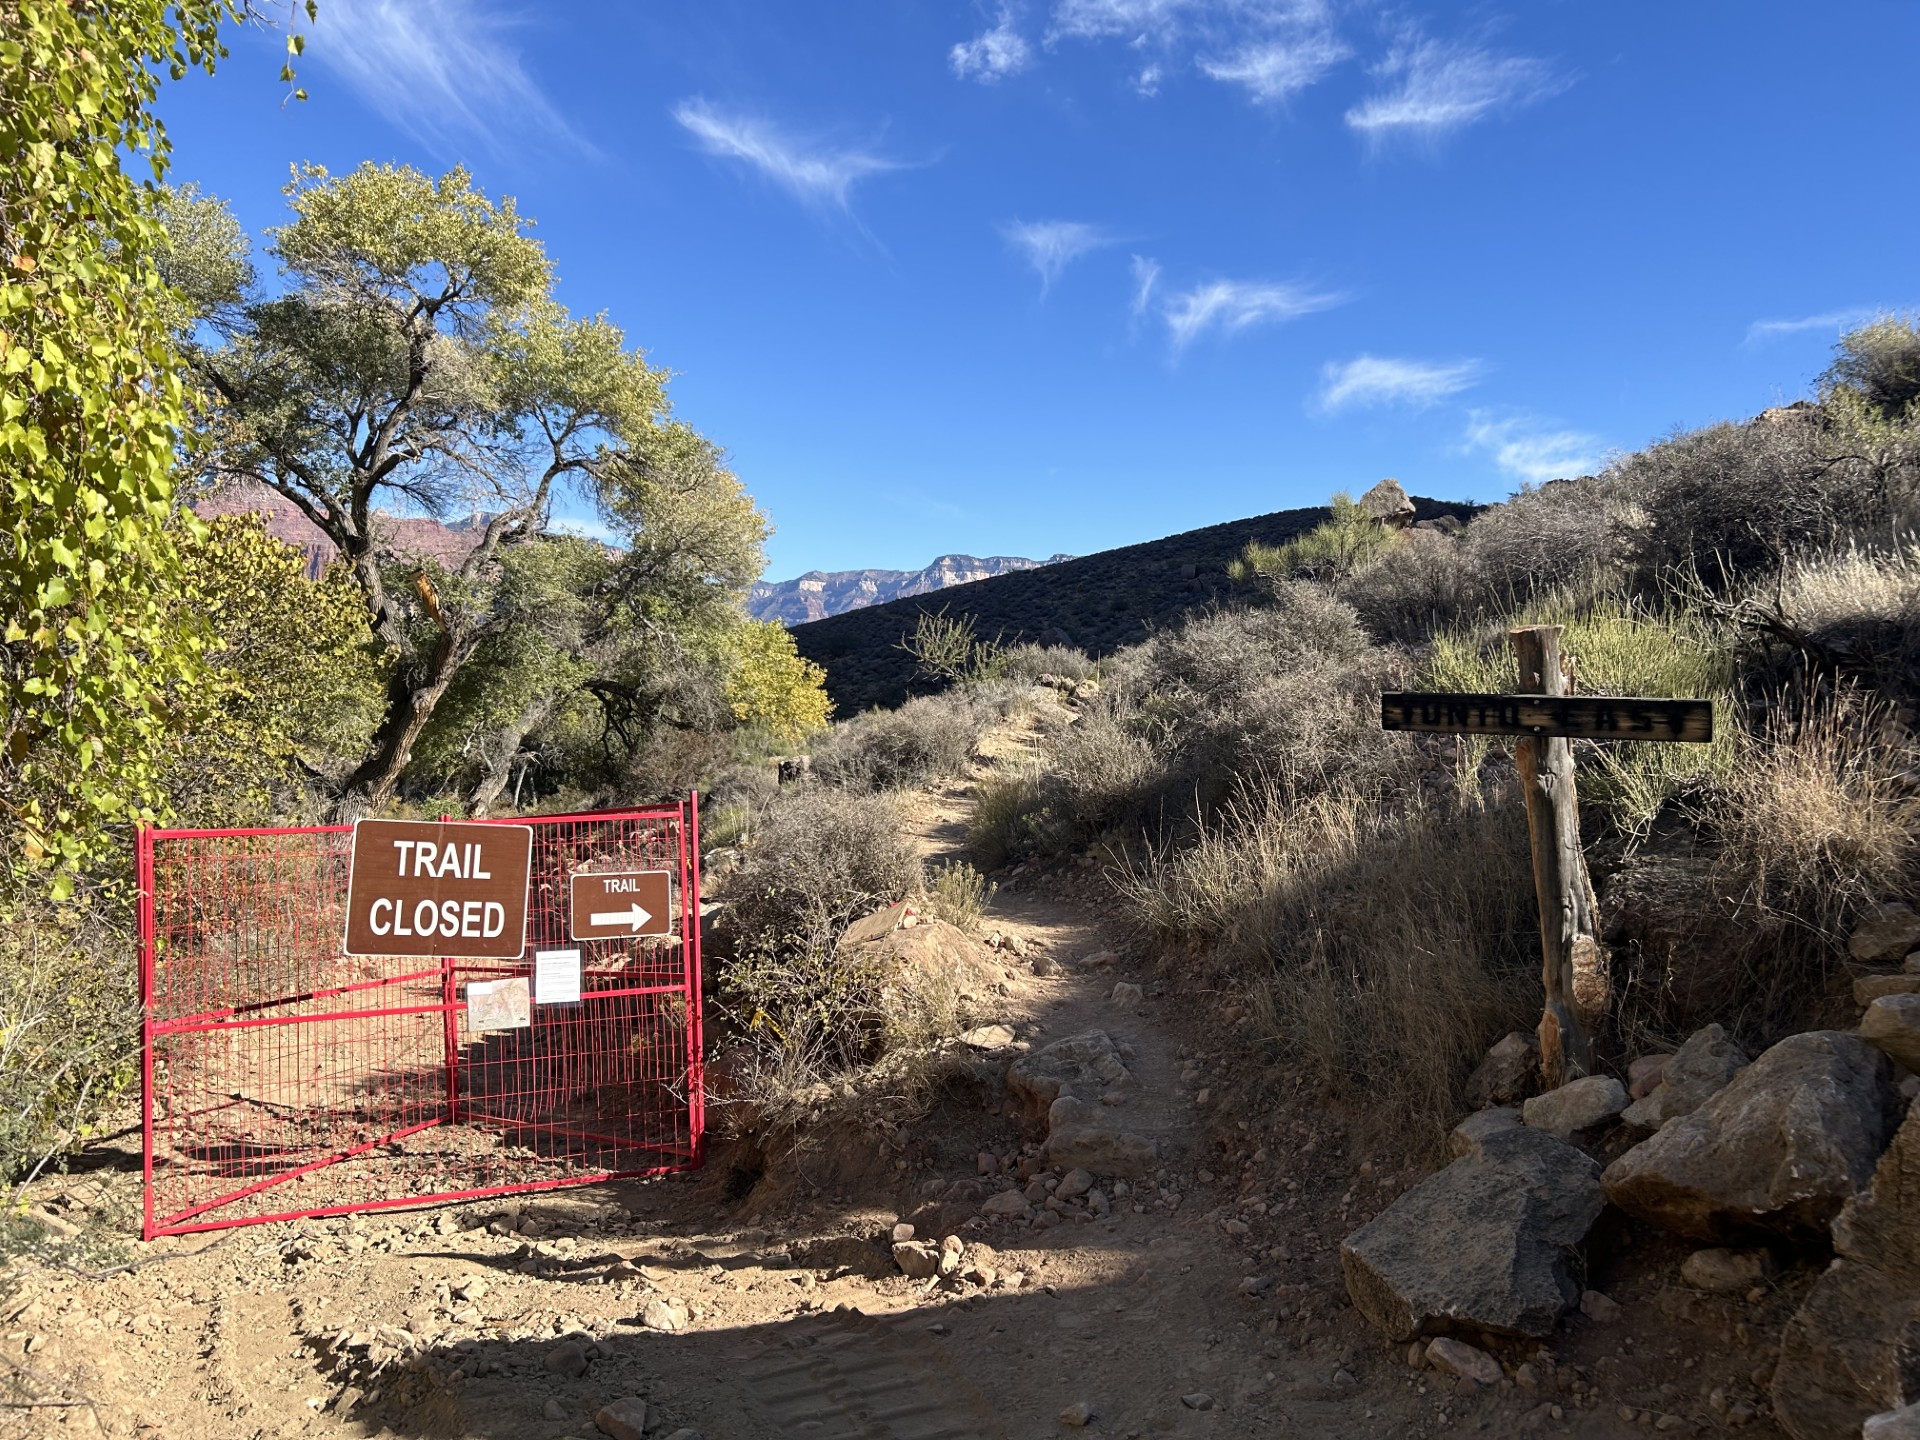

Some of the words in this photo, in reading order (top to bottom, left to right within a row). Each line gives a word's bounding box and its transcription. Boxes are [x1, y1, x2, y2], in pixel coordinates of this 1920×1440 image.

[393, 840, 491, 880] TRAIL
[603, 878, 641, 893] TRAIL
[369, 897, 506, 938] CLOSED
